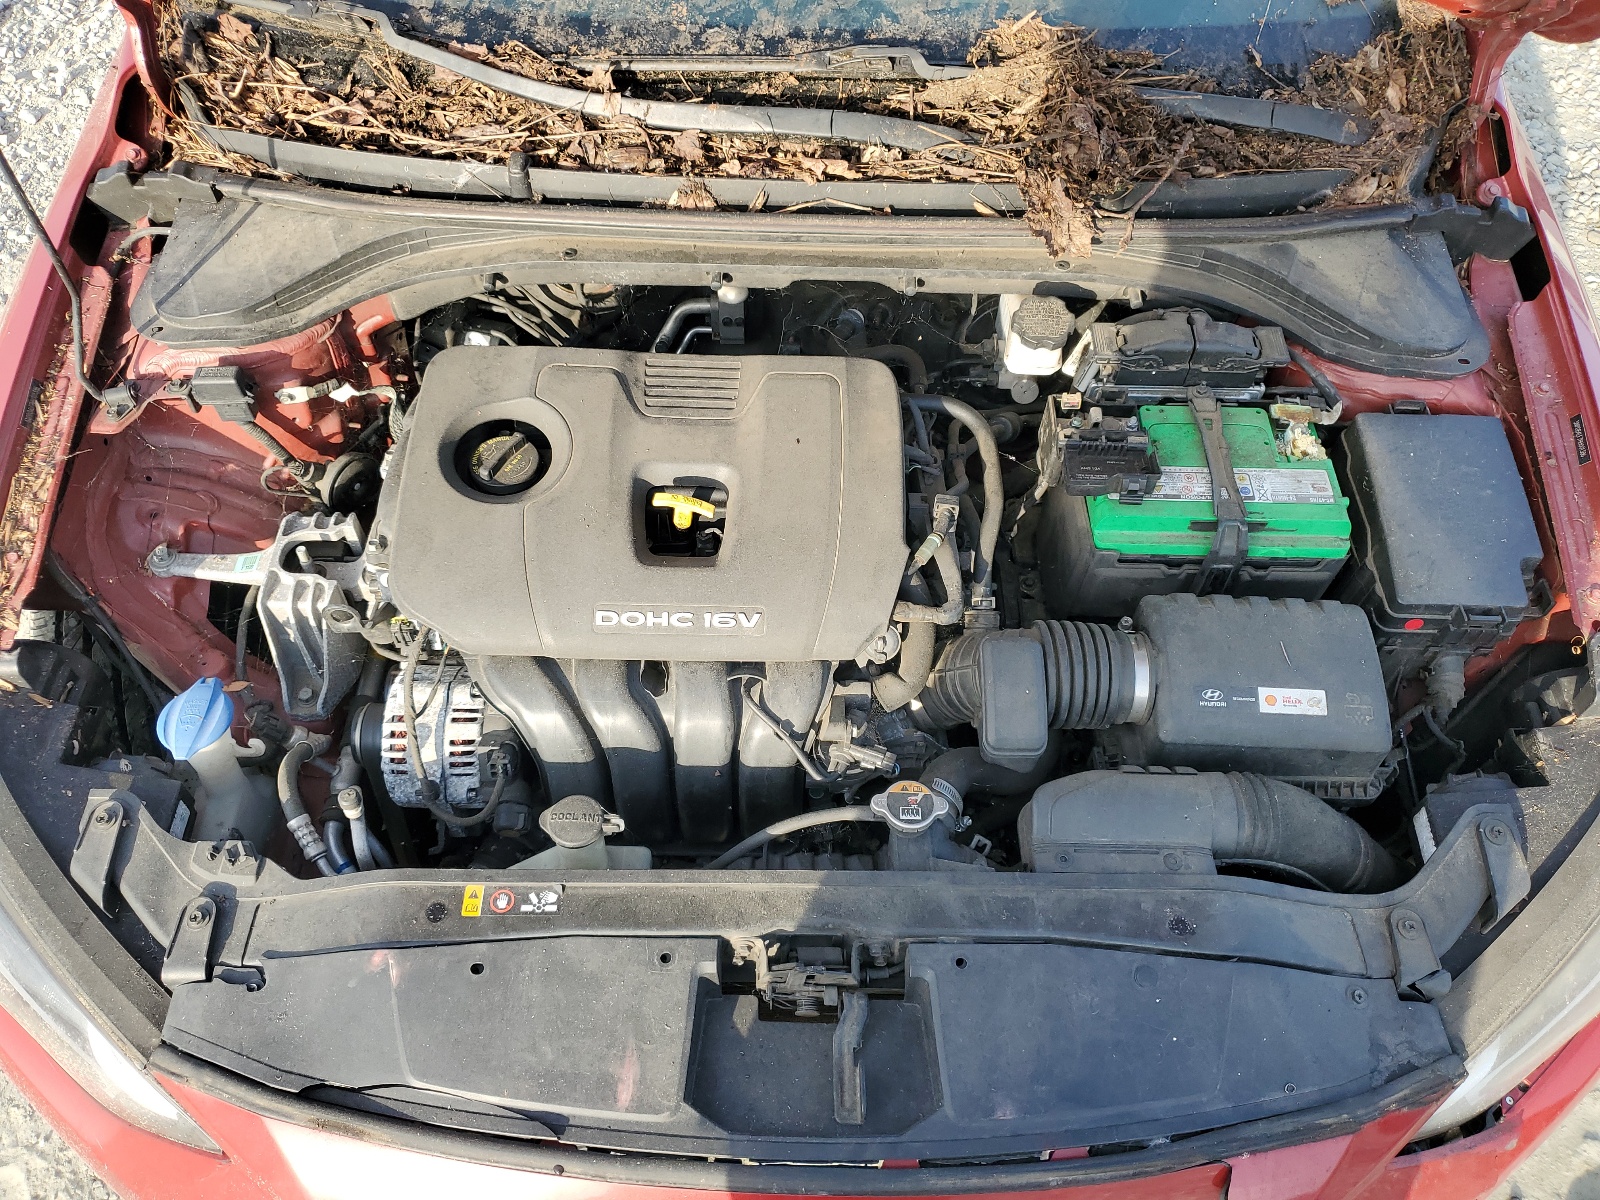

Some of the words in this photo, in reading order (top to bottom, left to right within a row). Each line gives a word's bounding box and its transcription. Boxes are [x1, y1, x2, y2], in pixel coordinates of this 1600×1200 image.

[595, 610, 695, 627] DOHC
[703, 611, 763, 628] 16V
[551, 812, 601, 823] COOLANT
